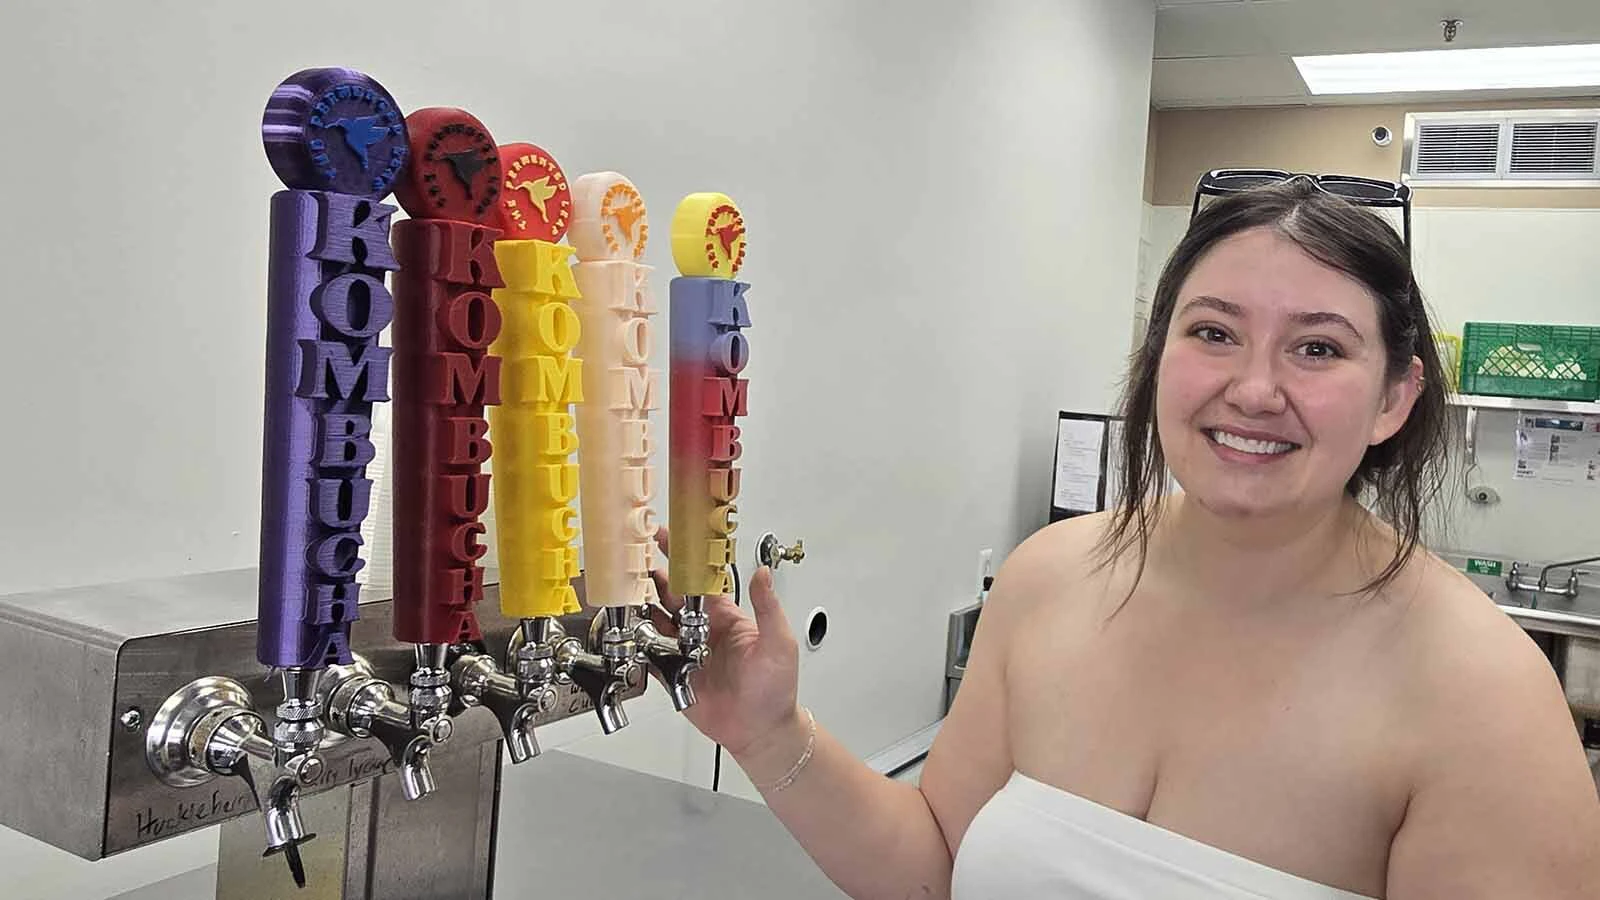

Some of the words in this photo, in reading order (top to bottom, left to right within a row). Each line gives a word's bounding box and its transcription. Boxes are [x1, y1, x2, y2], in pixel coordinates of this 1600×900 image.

[505, 154, 567, 190] FERMENTED
[298, 190, 400, 668] KOMBUCHA
[437, 218, 506, 644] KOMBUCHA
[534, 240, 584, 616] KOMBUCHA
[608, 262, 660, 605] KOMBUCHA
[703, 280, 752, 596] KOMBUCHA
